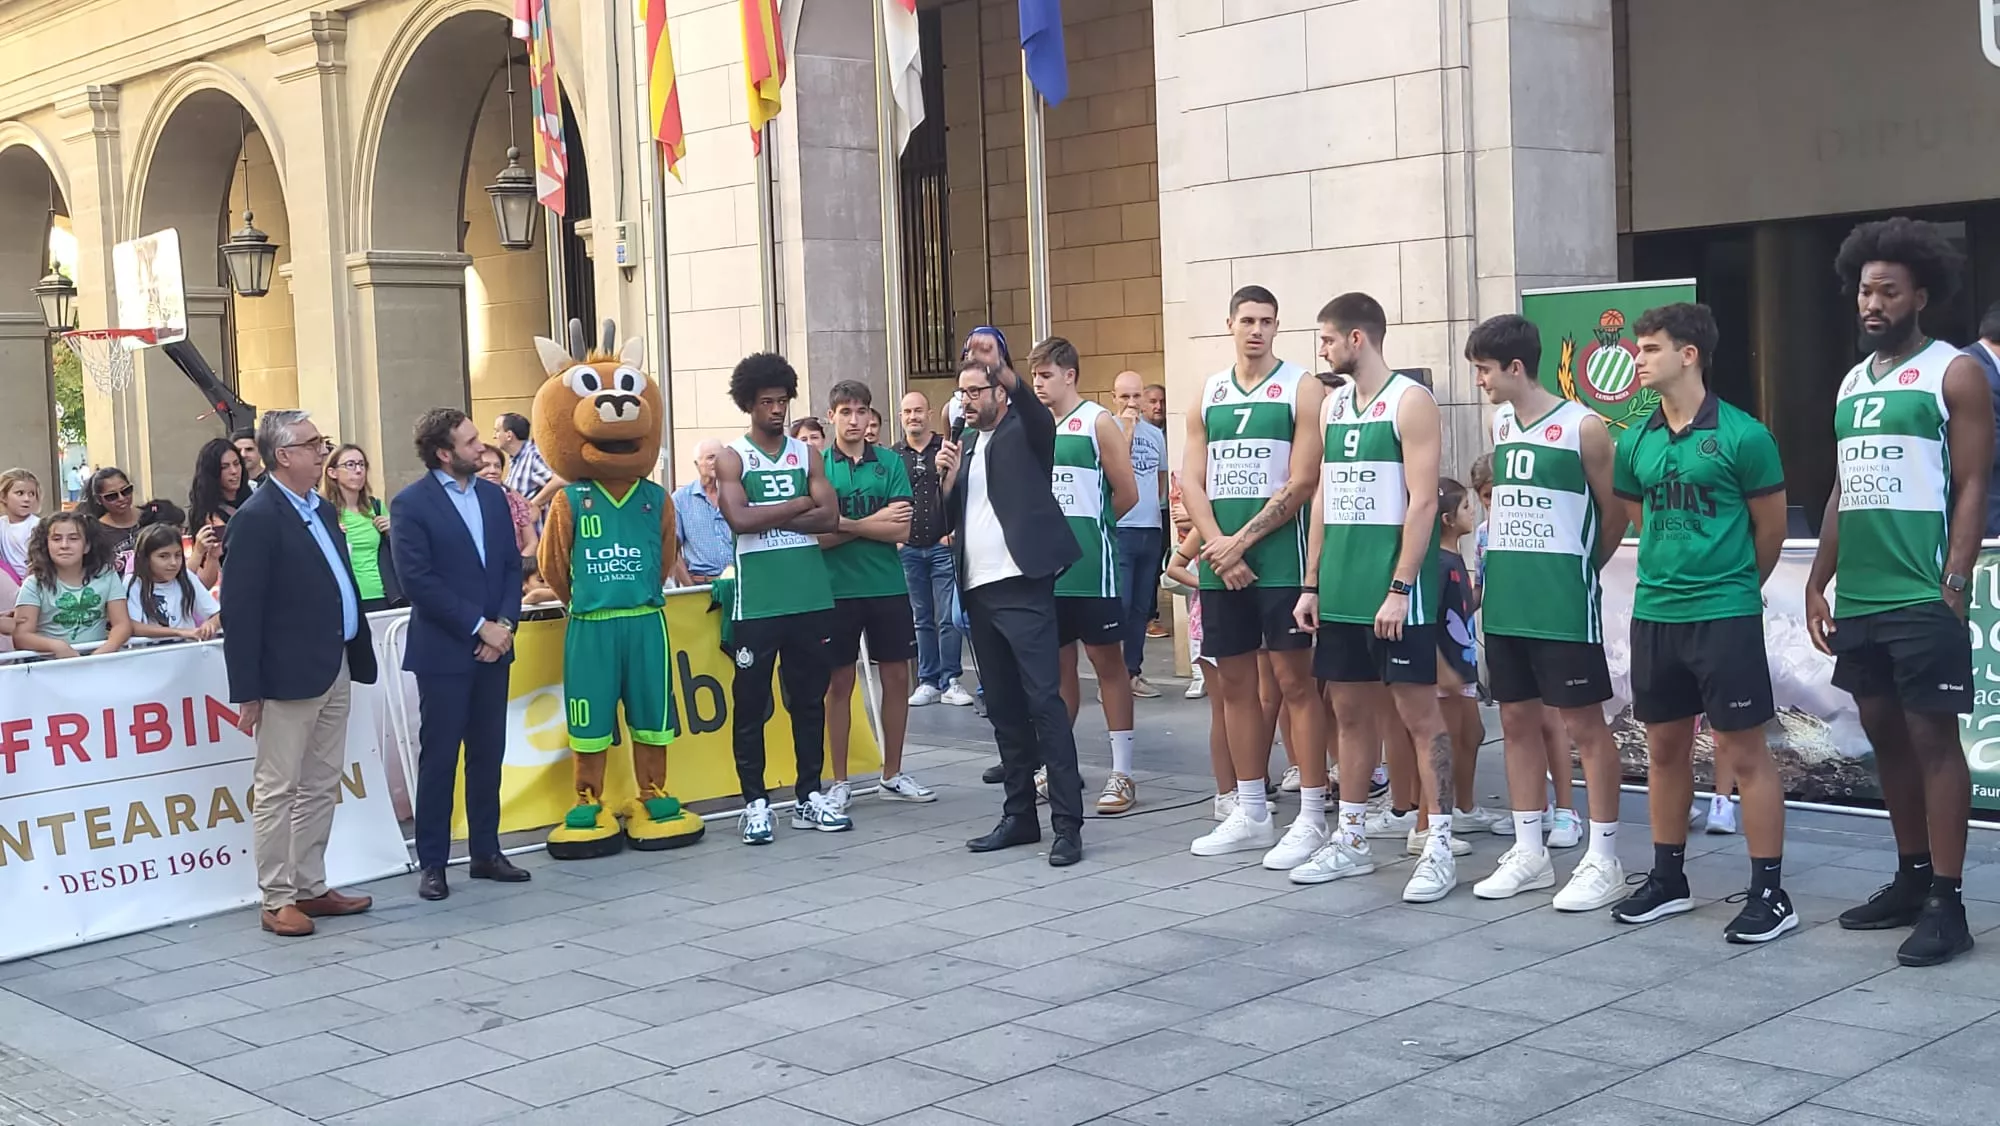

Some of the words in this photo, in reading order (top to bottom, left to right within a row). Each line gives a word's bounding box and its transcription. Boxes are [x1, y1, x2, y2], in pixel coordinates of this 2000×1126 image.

[1233, 407, 1253, 435] 7
[1853, 397, 1886, 429] 12
[1212, 442, 1272, 461] Lobe
[1344, 429, 1361, 458] 9
[1504, 448, 1536, 480] 10
[761, 474, 796, 498] 33
[1842, 473, 1903, 494] uesca
[580, 514, 602, 538] 00
[1498, 520, 1555, 538] uesca
[585, 543, 641, 560] Lobe
[570, 697, 590, 727] 00
[0, 762, 367, 867] NTEARAN
[59, 859, 159, 894] DESDE
[167, 845, 231, 876] 1966
